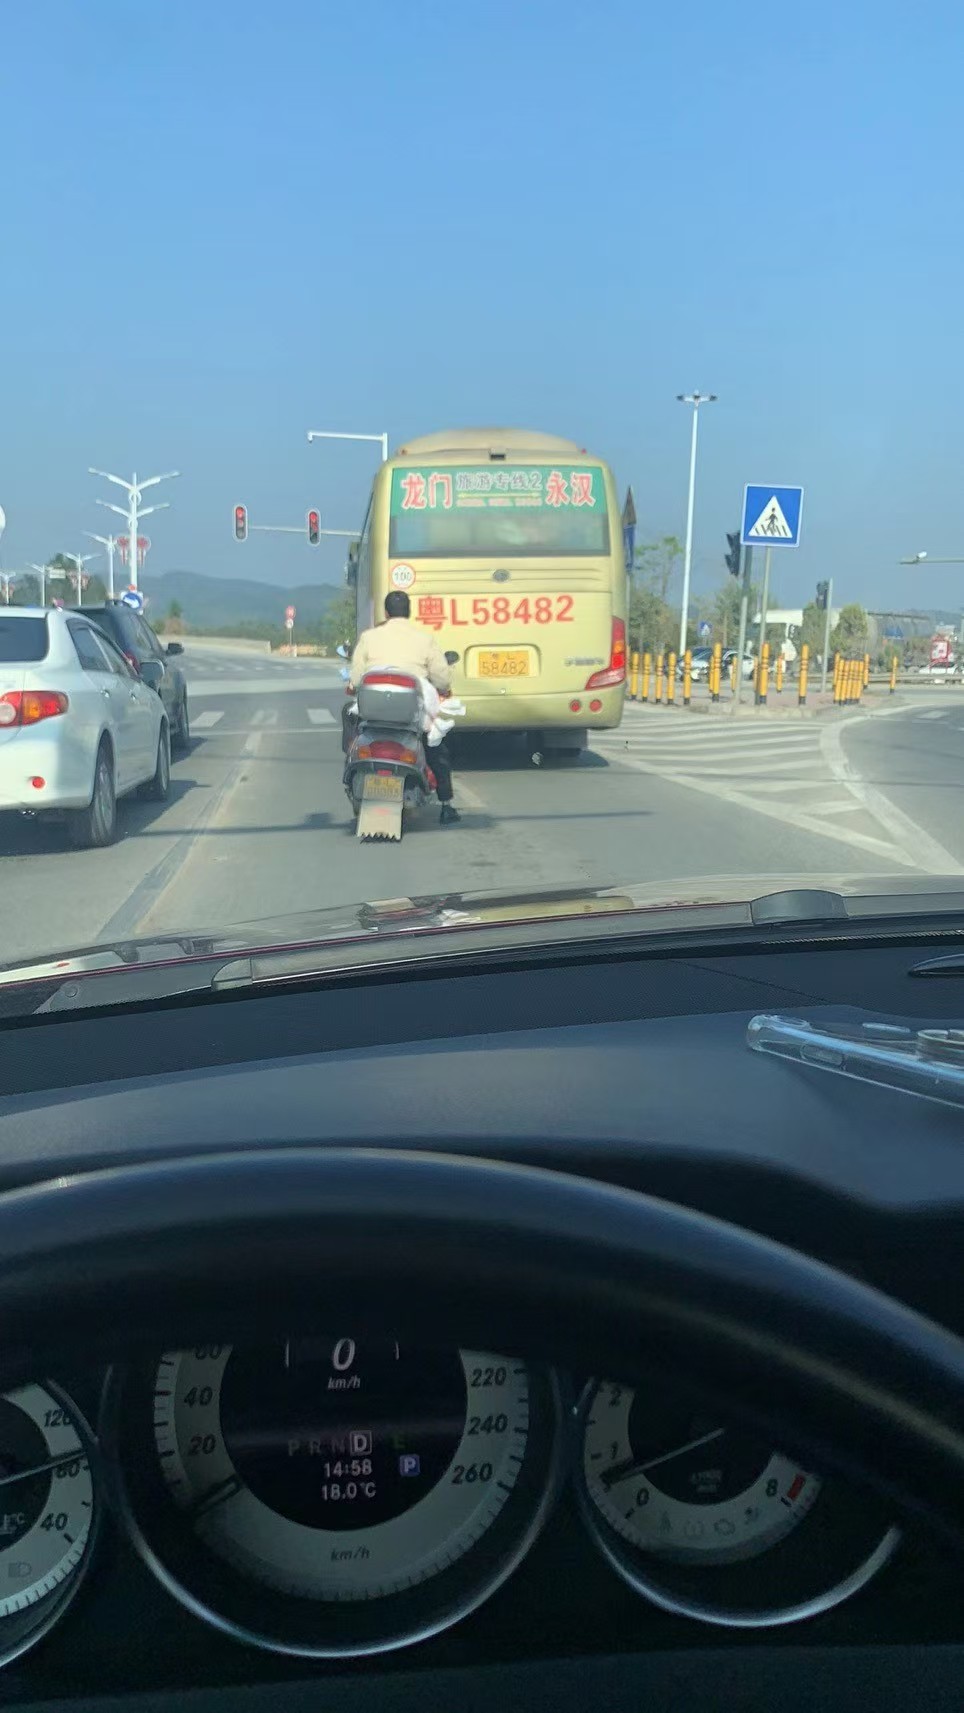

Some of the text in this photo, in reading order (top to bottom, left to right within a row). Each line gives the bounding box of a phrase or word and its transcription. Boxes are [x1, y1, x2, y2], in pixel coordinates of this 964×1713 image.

[401, 472, 453, 510] 龙门
[545, 471, 596, 508] 永汉
[415, 595, 574, 631] 粤L58482
[482, 660, 528, 676] 58482
[332, 1338, 356, 1371] 0
[327, 1375, 361, 1390] km/h
[471, 1367, 507, 1388] 220
[184, 1386, 213, 1408] 40
[467, 1413, 508, 1435] 240
[188, 1433, 217, 1456] 20
[353, 1434, 368, 1453] D
[323, 1458, 373, 1479] 14:58
[403, 1457, 417, 1474] P
[451, 1462, 493, 1486] 260
[636, 1487, 650, 1507] 0
[765, 1478, 778, 1498] 8
[40, 1512, 69, 1532] 40
[330, 1546, 371, 1561] km/h
